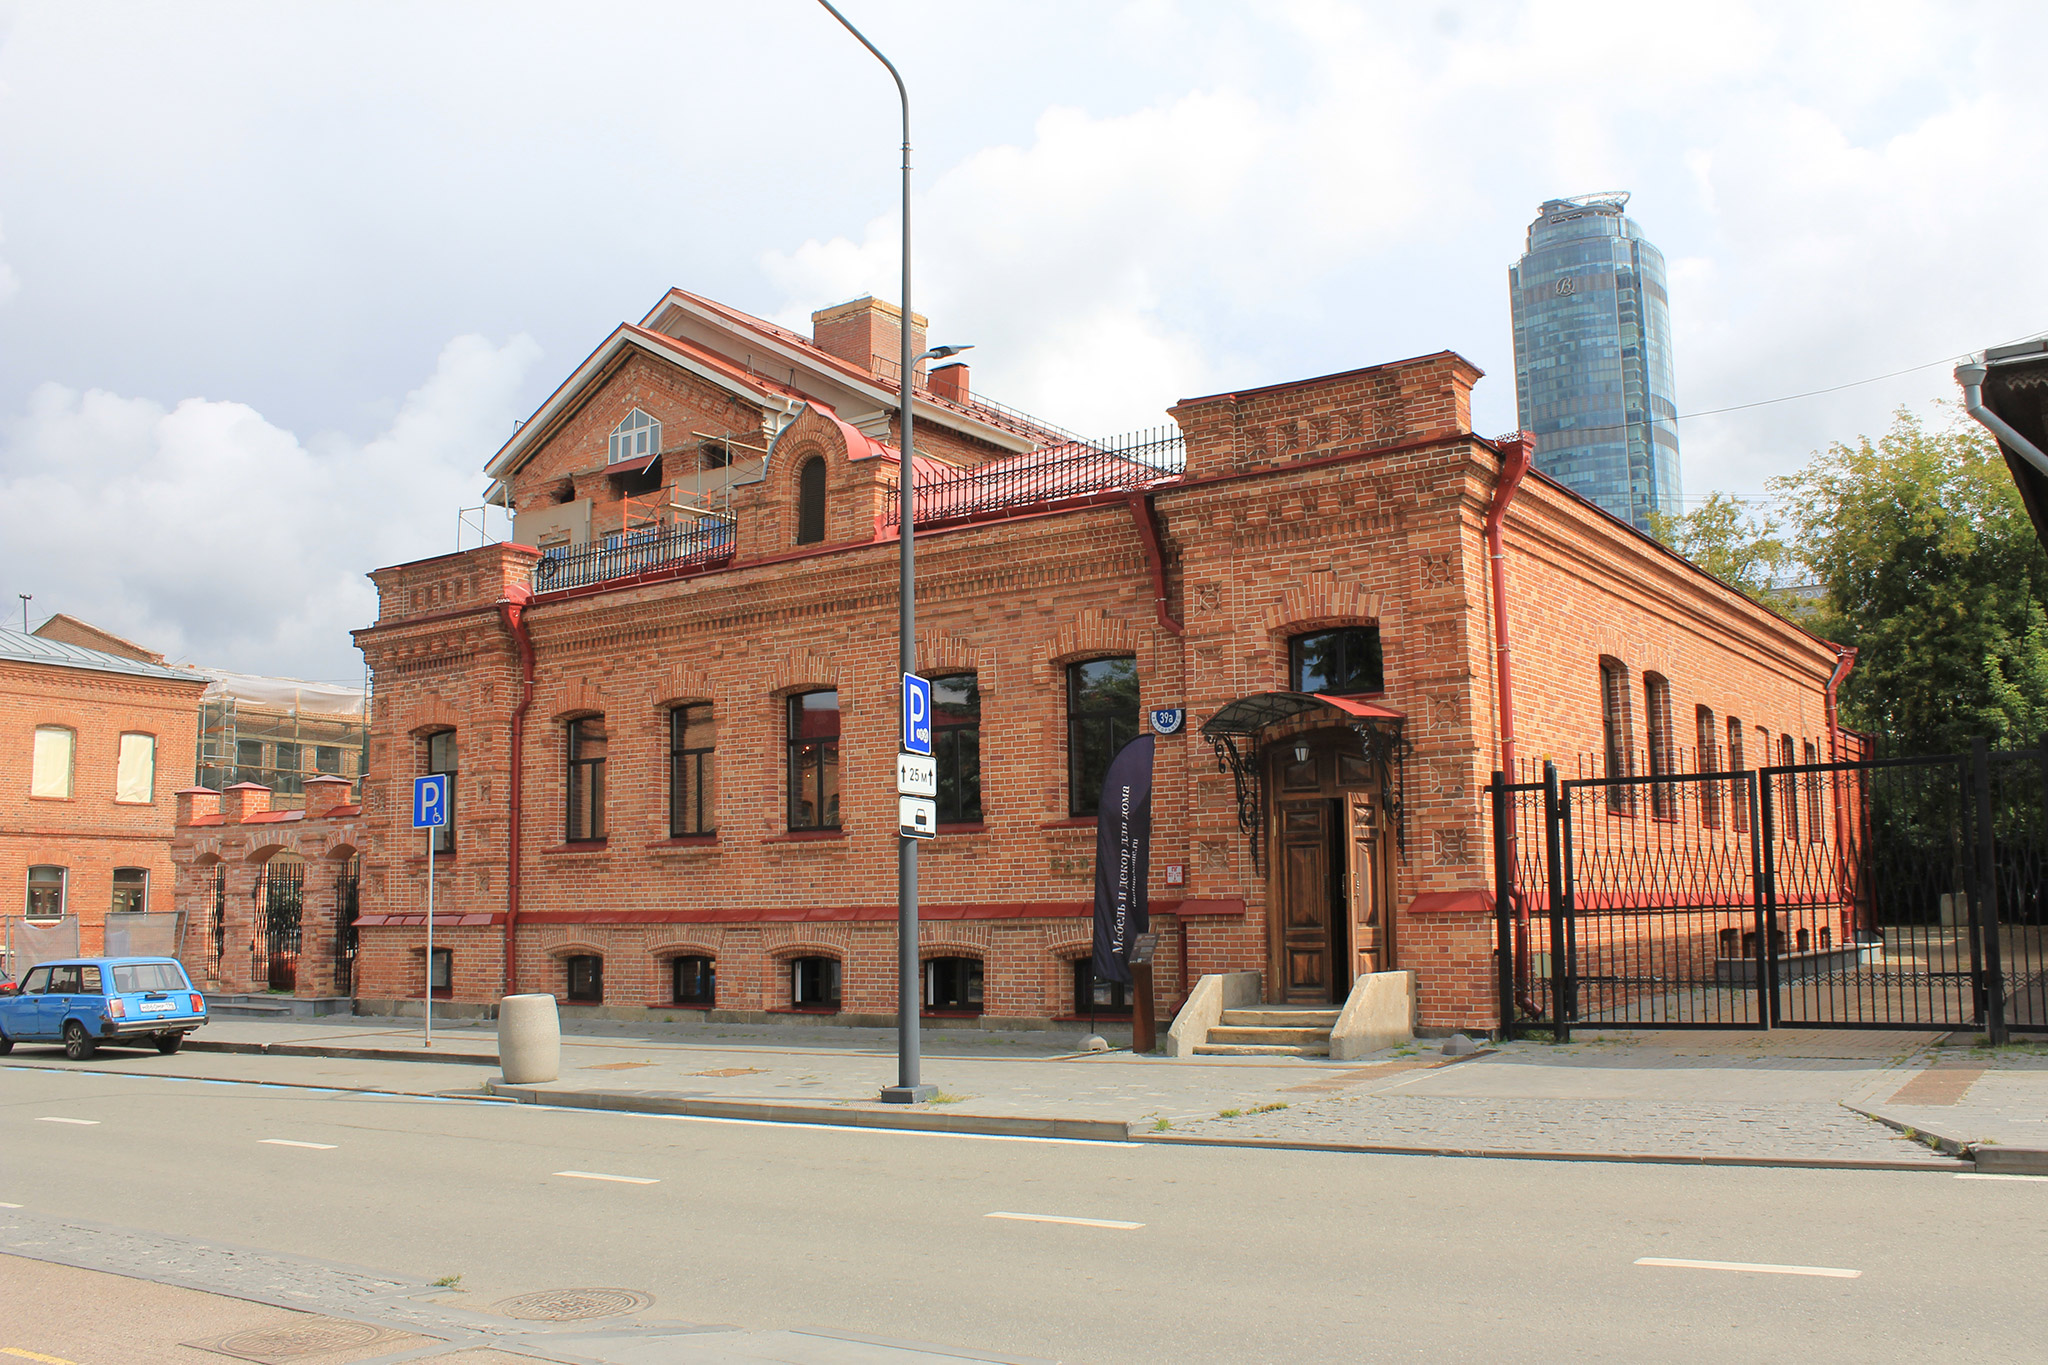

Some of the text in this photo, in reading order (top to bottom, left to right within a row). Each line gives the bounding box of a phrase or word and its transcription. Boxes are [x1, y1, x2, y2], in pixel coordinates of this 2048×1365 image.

[910, 683, 924, 742] P
[1159, 712, 1174, 724] 39а
[909, 768, 920, 782] 25
[421, 782, 439, 821] P
[1112, 785, 1131, 955] Мебель и декор для дома
